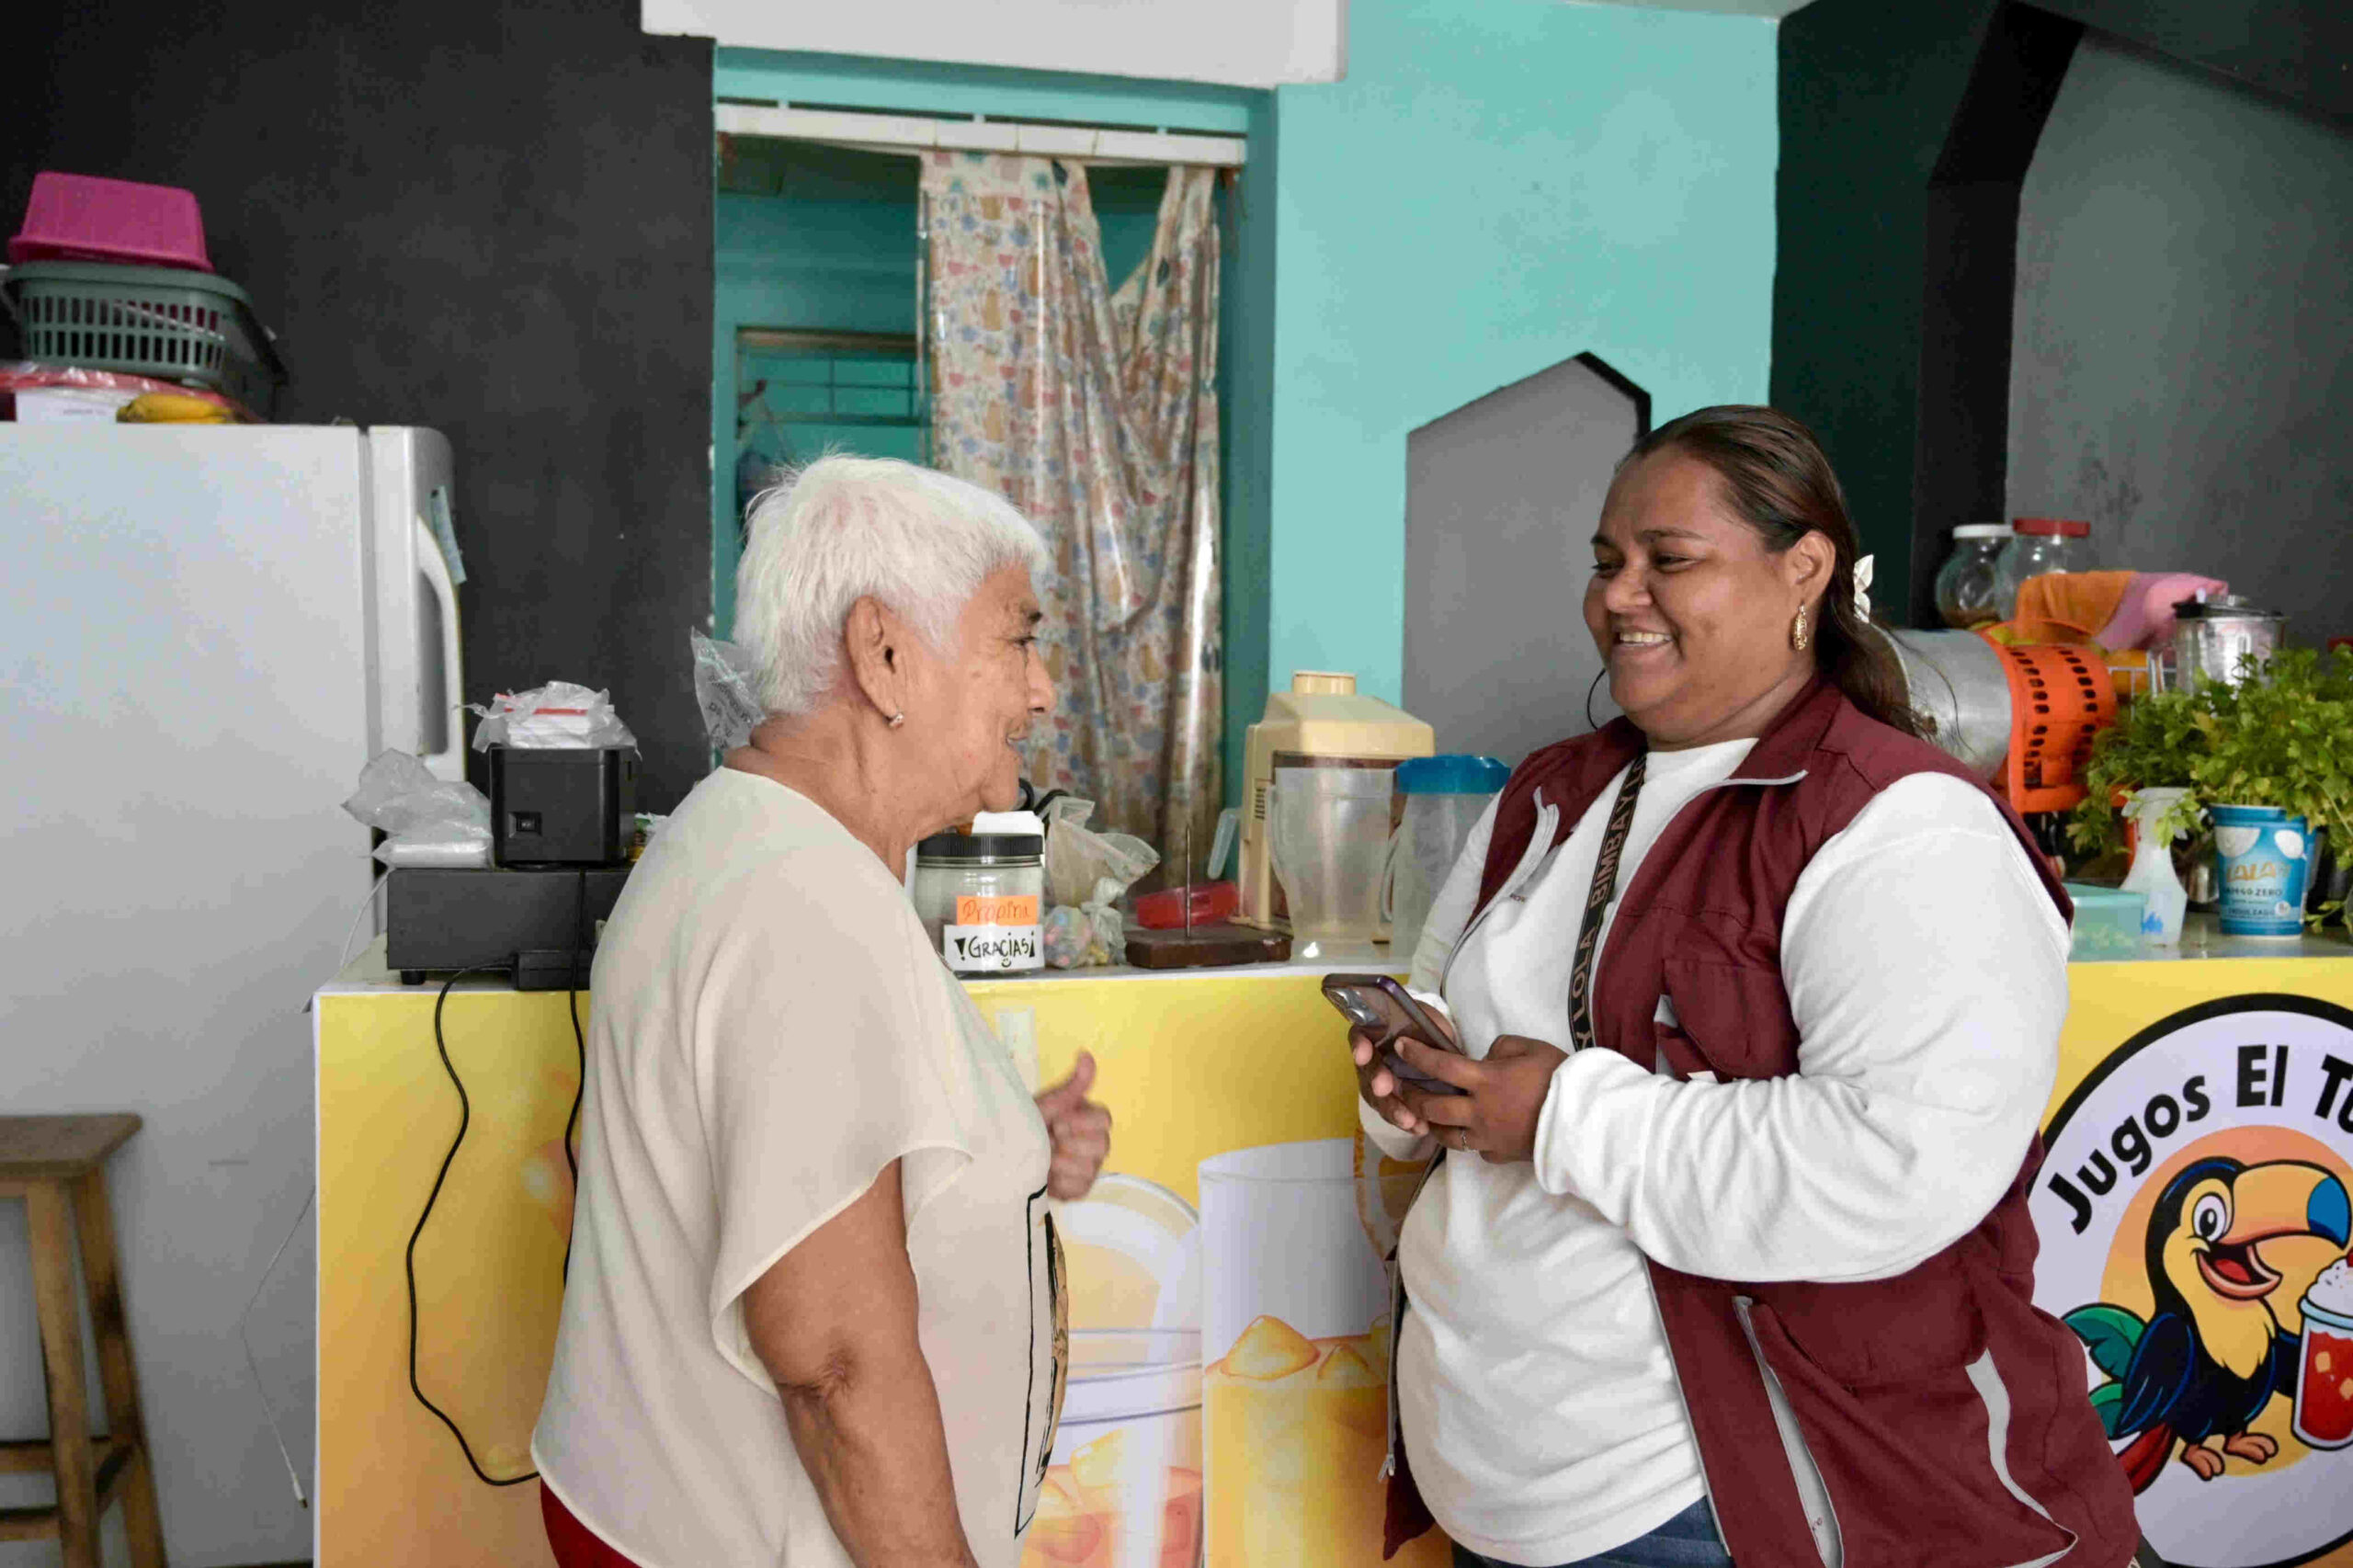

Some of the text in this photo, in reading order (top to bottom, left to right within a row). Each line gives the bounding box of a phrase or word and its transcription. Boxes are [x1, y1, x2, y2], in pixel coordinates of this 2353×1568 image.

[1573, 926, 1597, 1021] LOLA
[2048, 1075, 2211, 1235] Jugos
[2236, 1045, 2289, 1108] El
